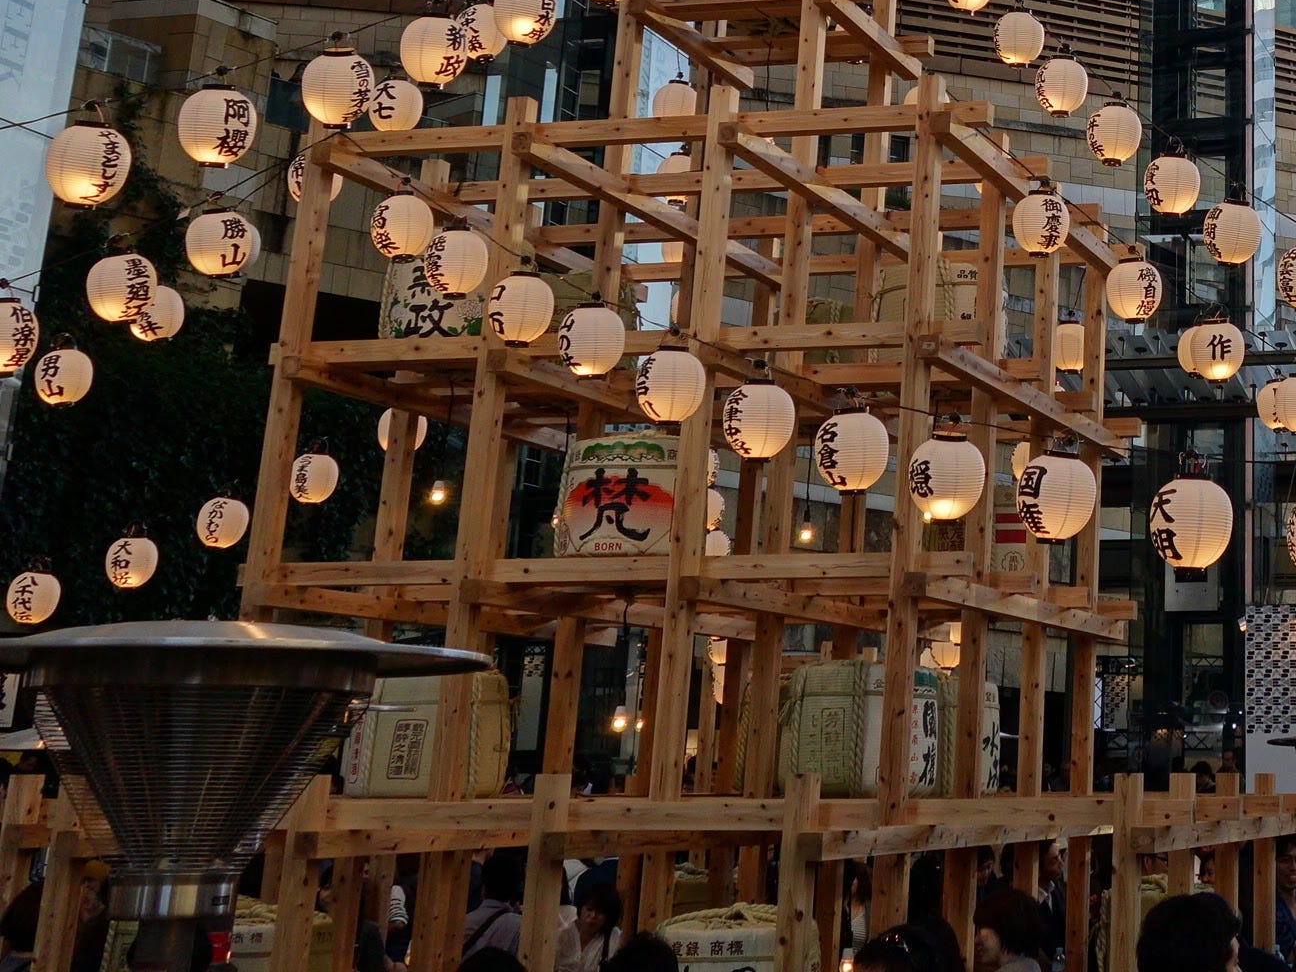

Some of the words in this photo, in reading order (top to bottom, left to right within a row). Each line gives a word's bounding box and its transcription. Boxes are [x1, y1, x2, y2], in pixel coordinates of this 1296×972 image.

[434, 24, 467, 77] 新政
[373, 82, 397, 120] 大七
[79, 129, 121, 203] やまとしずく
[220, 217, 248, 267] 勝山
[1039, 198, 1062, 250] 御慶事
[425, 235, 449, 292] 飛露喜
[1136, 267, 1158, 317] 磯自慢
[3, 305, 36, 367] 伯楽星
[1206, 333, 1232, 361] 作
[40, 354, 64, 398] 男山
[816, 421, 848, 487] 名倉山
[204, 499, 228, 544] なかむら
[579, 467, 651, 542] 梵
[1150, 488, 1183, 561] 天明
[594, 542, 622, 552] BORN
